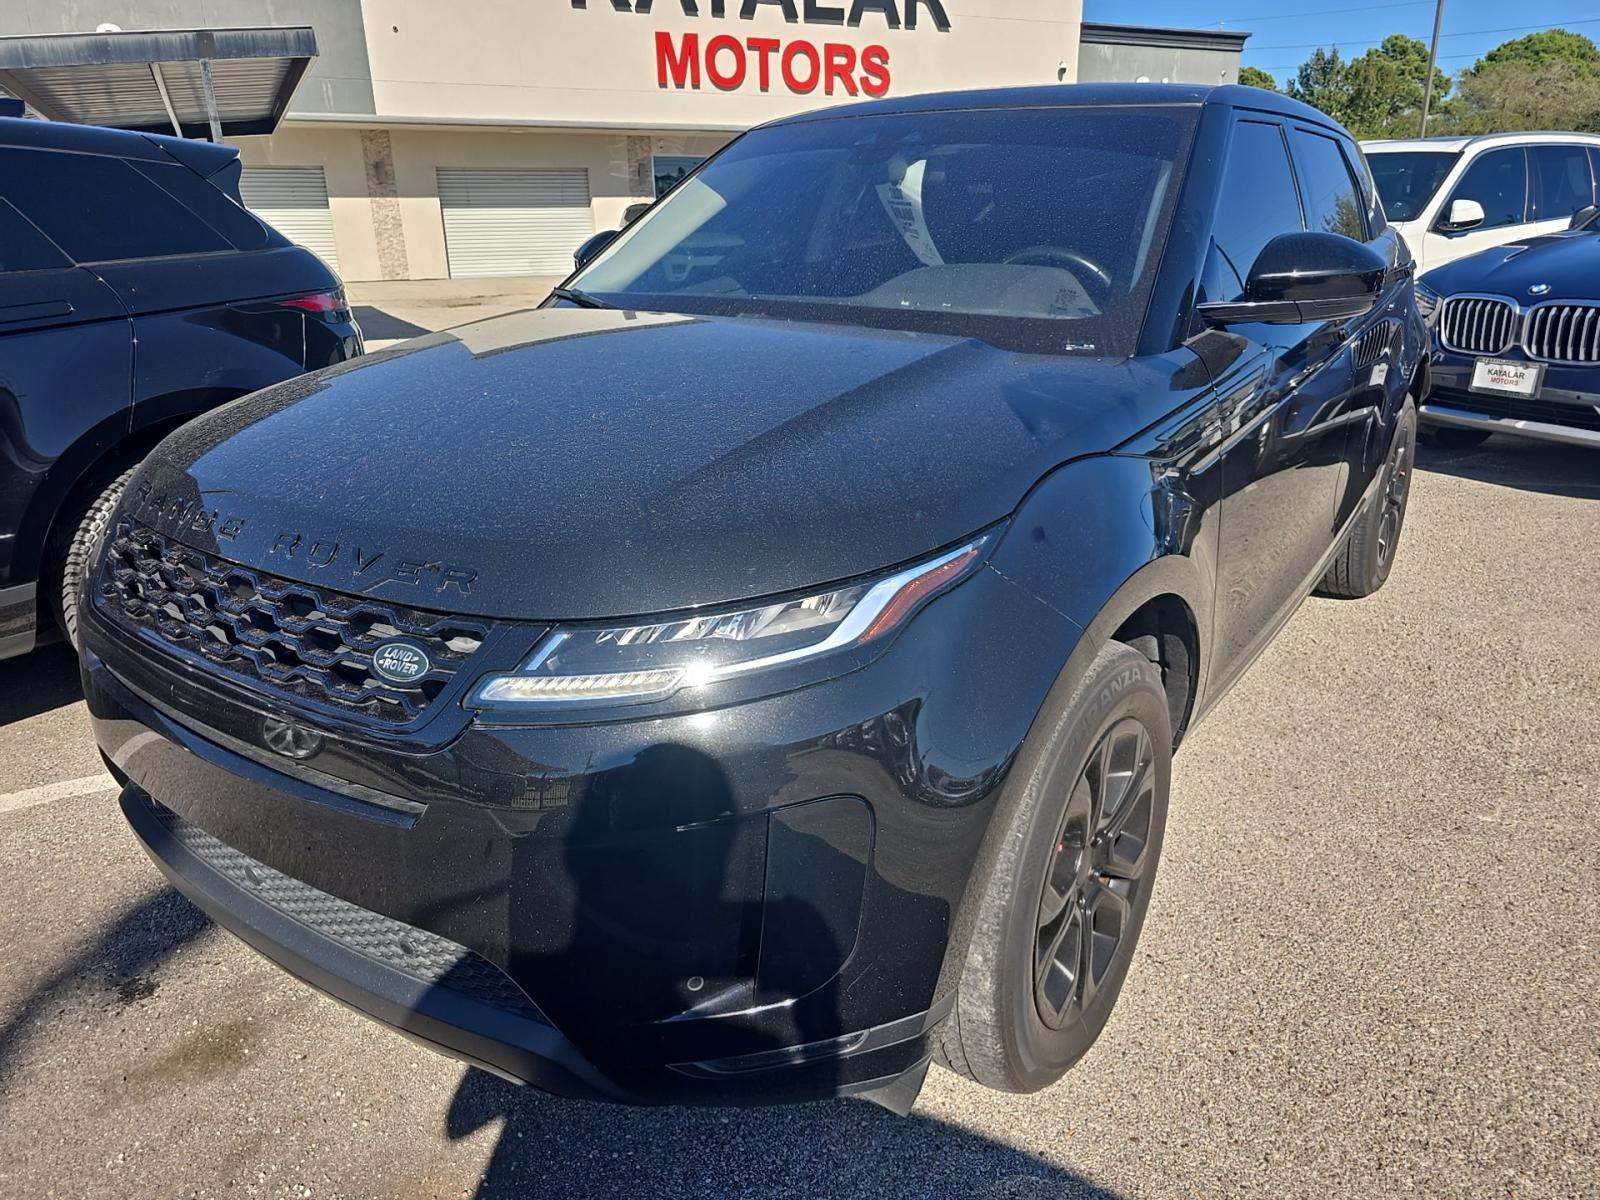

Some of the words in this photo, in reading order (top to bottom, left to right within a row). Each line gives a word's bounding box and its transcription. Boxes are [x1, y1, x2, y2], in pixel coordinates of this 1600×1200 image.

[655, 31, 891, 98] MOTORS
[1487, 368, 1526, 380] KAYALAR
[1490, 376, 1519, 386] MOTORS
[269, 533, 479, 595] ROVER
[384, 647, 413, 662] LAND
[382, 657, 419, 675] ROVER
